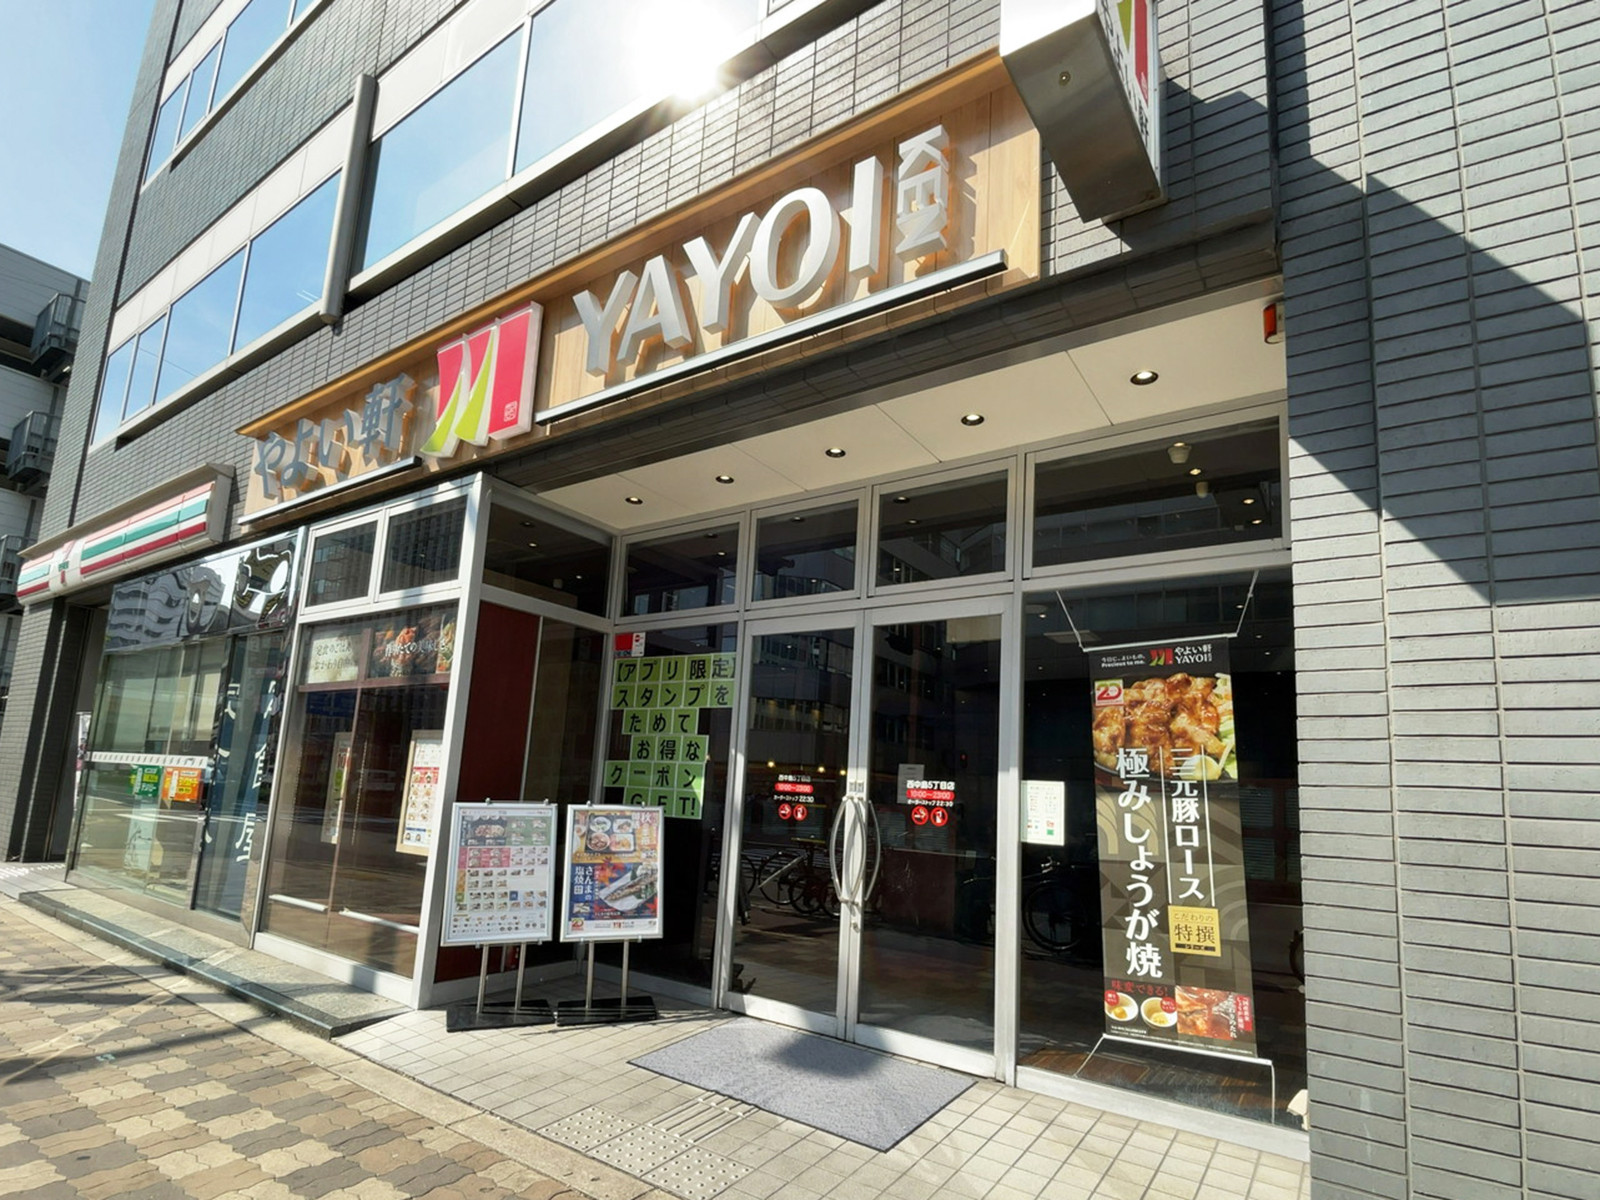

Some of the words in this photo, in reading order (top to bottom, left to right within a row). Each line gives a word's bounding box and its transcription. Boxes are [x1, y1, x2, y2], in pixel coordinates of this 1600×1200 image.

[895, 124, 950, 261] KEN
[572, 155, 884, 377] YAYOI
[254, 372, 410, 500] やよい軒
[1174, 644, 1213, 657] やよい軒
[1174, 653, 1208, 665] YAYOI
[616, 684, 729, 707] スタンプを
[629, 713, 691, 733] ためて
[637, 739, 701, 761] お得な
[611, 764, 697, 788] クーポン
[906, 780, 956, 790] 西中島5丁目店
[630, 793, 696, 816] GET!
[1169, 747, 1205, 901] 三元豚ロース
[1115, 747, 1163, 979] 極みしょうが焼
[1174, 912, 1214, 922] こだわりの
[1174, 923, 1216, 944] 特撰
